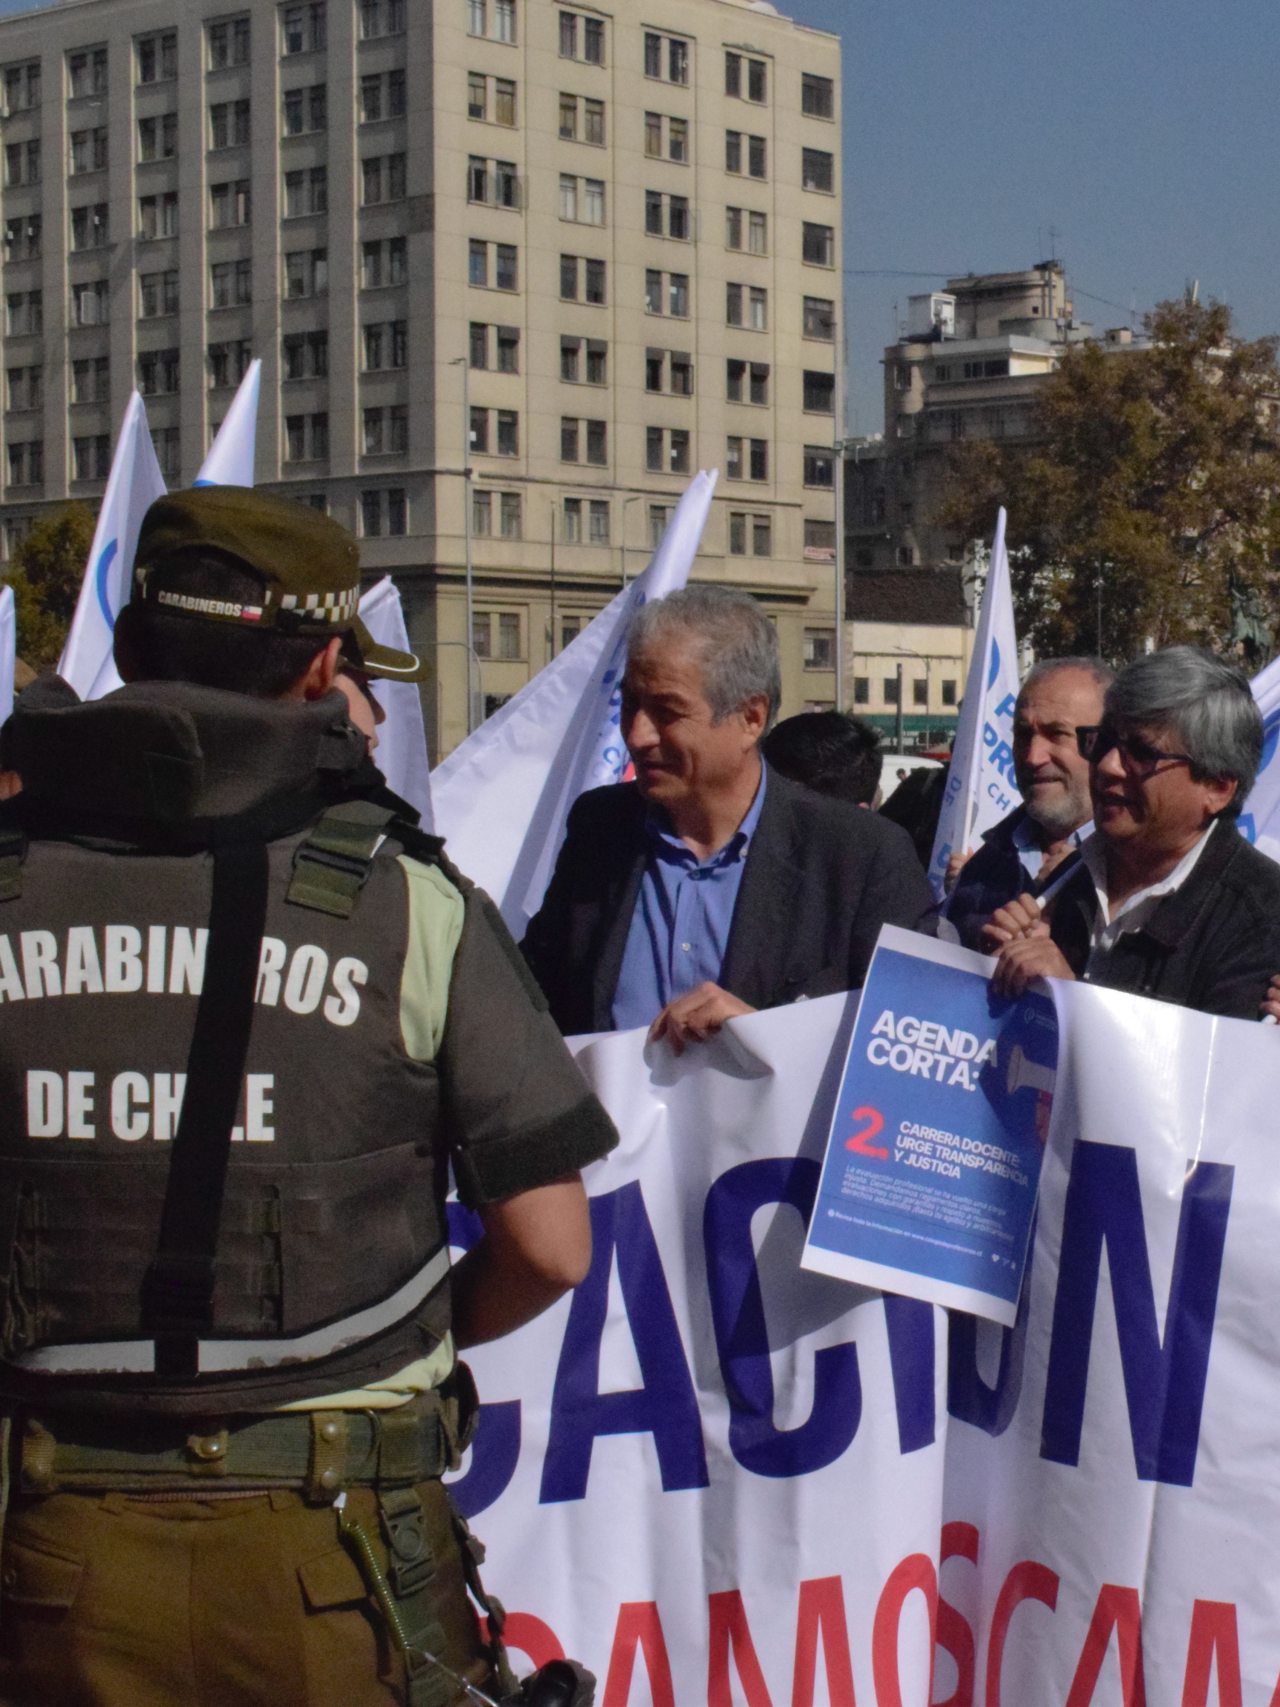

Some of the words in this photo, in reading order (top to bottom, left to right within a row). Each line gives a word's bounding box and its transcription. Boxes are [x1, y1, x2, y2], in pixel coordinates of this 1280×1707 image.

[158, 590, 243, 617] CARABINEROS
[867, 1037, 979, 1092] CORTA:
[871, 1009, 998, 1068] AGENDA
[26, 1070, 96, 1139] DE
[111, 1071, 275, 1141] CHE
[900, 1121, 961, 1148] CARRERA
[893, 1149, 905, 1163] Y
[904, 1154, 961, 1179] JUSTICIA
[896, 1135, 934, 1156] URGE
[935, 1145, 1029, 1187] TRANSPARENCIA
